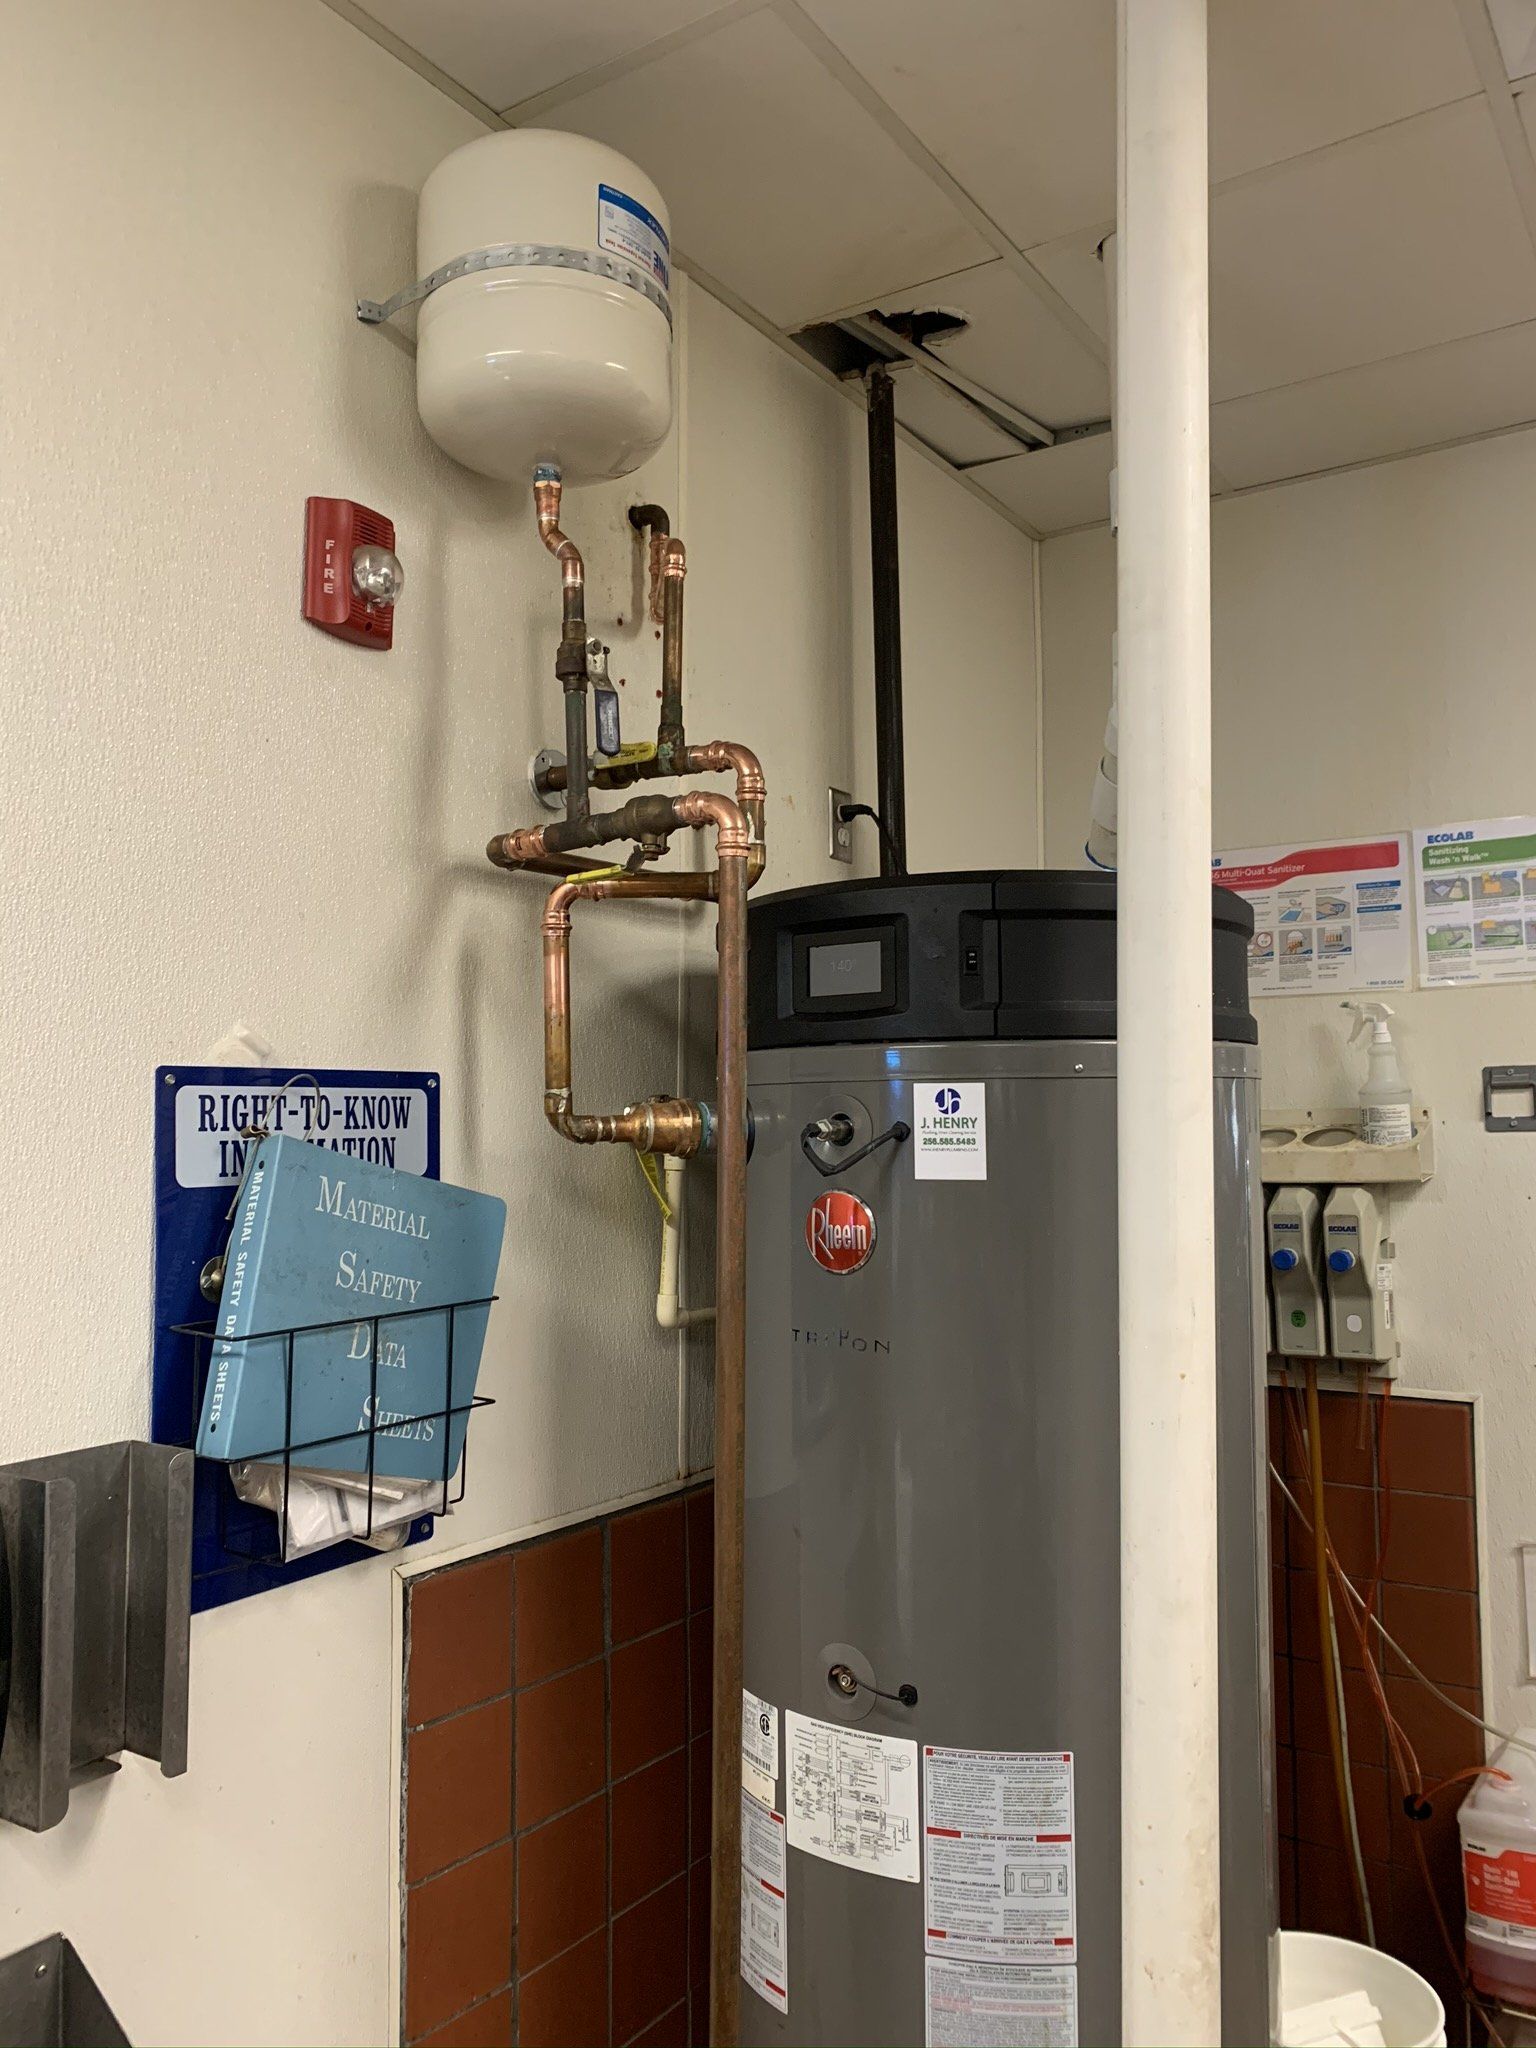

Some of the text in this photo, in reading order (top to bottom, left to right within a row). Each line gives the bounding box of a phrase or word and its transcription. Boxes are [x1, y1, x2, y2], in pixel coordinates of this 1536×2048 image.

[323, 539, 335, 594] FIRE
[1427, 831, 1474, 844] ECOLAB
[1428, 847, 1469, 857] Sanitizing
[1221, 867, 1265, 879] Multi-Quat
[1267, 864, 1305, 875] Sanitizer
[1428, 856, 1451, 865] Wash
[198, 1094, 412, 1132] RIGHT-TO-KNOW
[920, 1117, 978, 1129] J. HENRY
[315, 1175, 431, 1240] MATERIAL
[811, 1197, 867, 1260] Rheem
[210, 1171, 264, 1421] MATERIAL SAFETY DAA SHEETS
[335, 1250, 422, 1303] SAFETY
[347, 1322, 406, 1369] DATA
